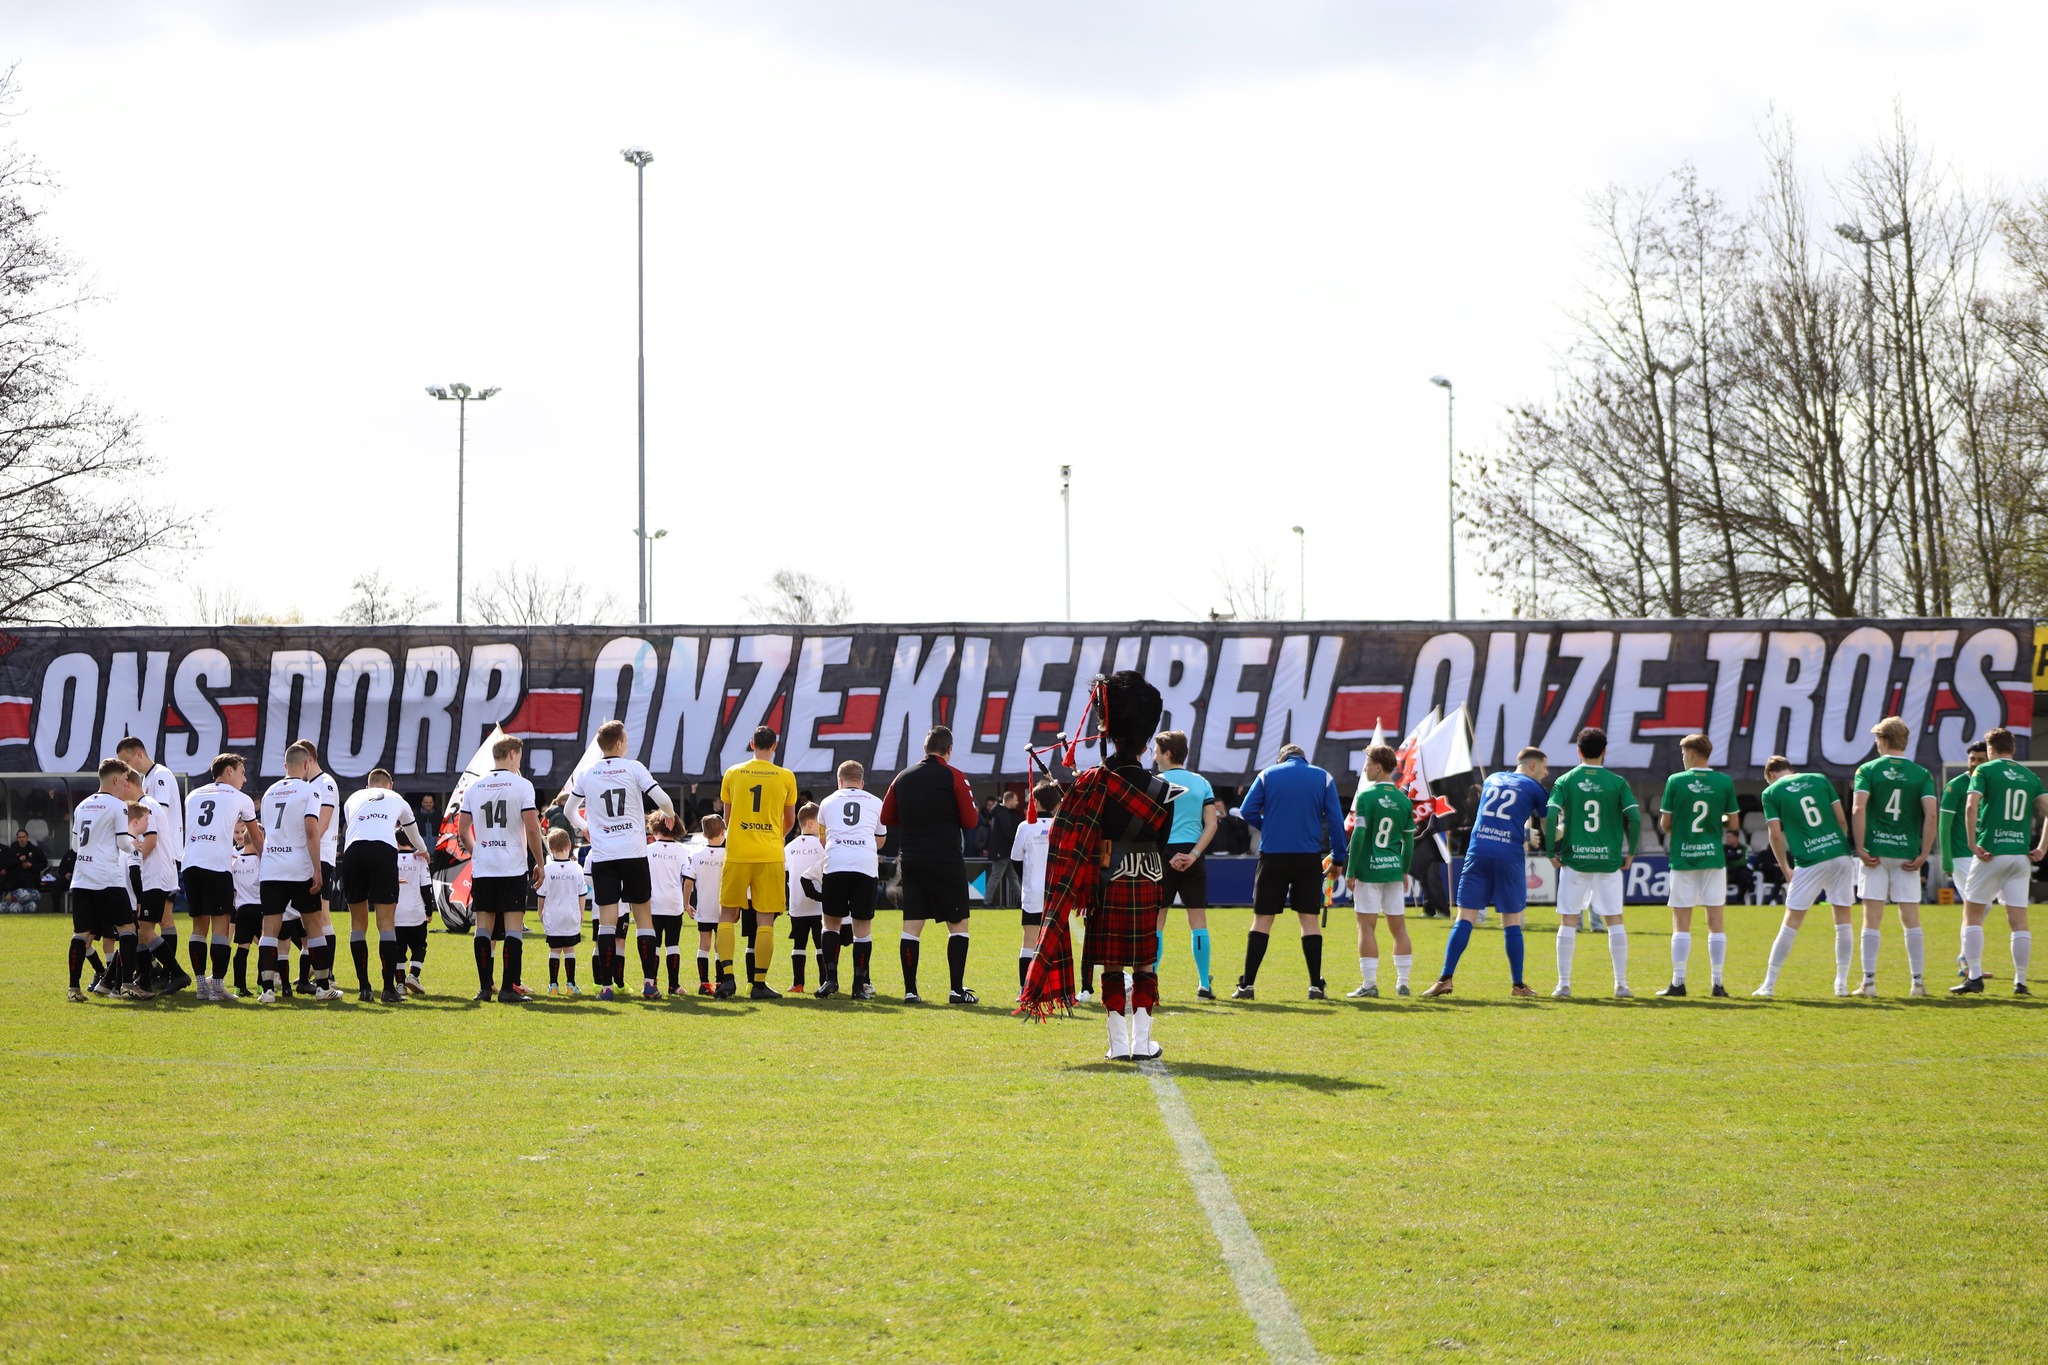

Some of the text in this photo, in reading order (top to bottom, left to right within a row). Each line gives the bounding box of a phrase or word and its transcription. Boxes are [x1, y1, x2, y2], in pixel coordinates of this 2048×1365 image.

[34, 648, 231, 777] ONS
[585, 634, 853, 776] ONZE
[1404, 632, 1673, 768] ONZE
[1707, 627, 2019, 767] TROTS
[600, 788, 626, 817] 17
[750, 784, 762, 812] 1
[1482, 786, 1517, 821] 22
[1800, 795, 1822, 827] 6
[1884, 788, 1901, 821] 4
[2004, 788, 2027, 821] 10
[198, 800, 215, 827] 3
[274, 802, 287, 829] 7
[480, 800, 508, 829] 14
[610, 822, 633, 832] STOLZE
[749, 822, 773, 831] STOLZE
[843, 801, 861, 826] 9
[1583, 800, 1600, 833] 3
[1691, 800, 1708, 833] 2
[80, 820, 92, 847] 5
[1375, 817, 1393, 848] 8
[1478, 825, 1511, 838] Lievaart
[1803, 832, 1839, 848] Lievaart
[1995, 829, 2024, 838] Lievaart
[1572, 845, 1609, 853] Lievaart
[1682, 842, 1715, 851] Lievaart
